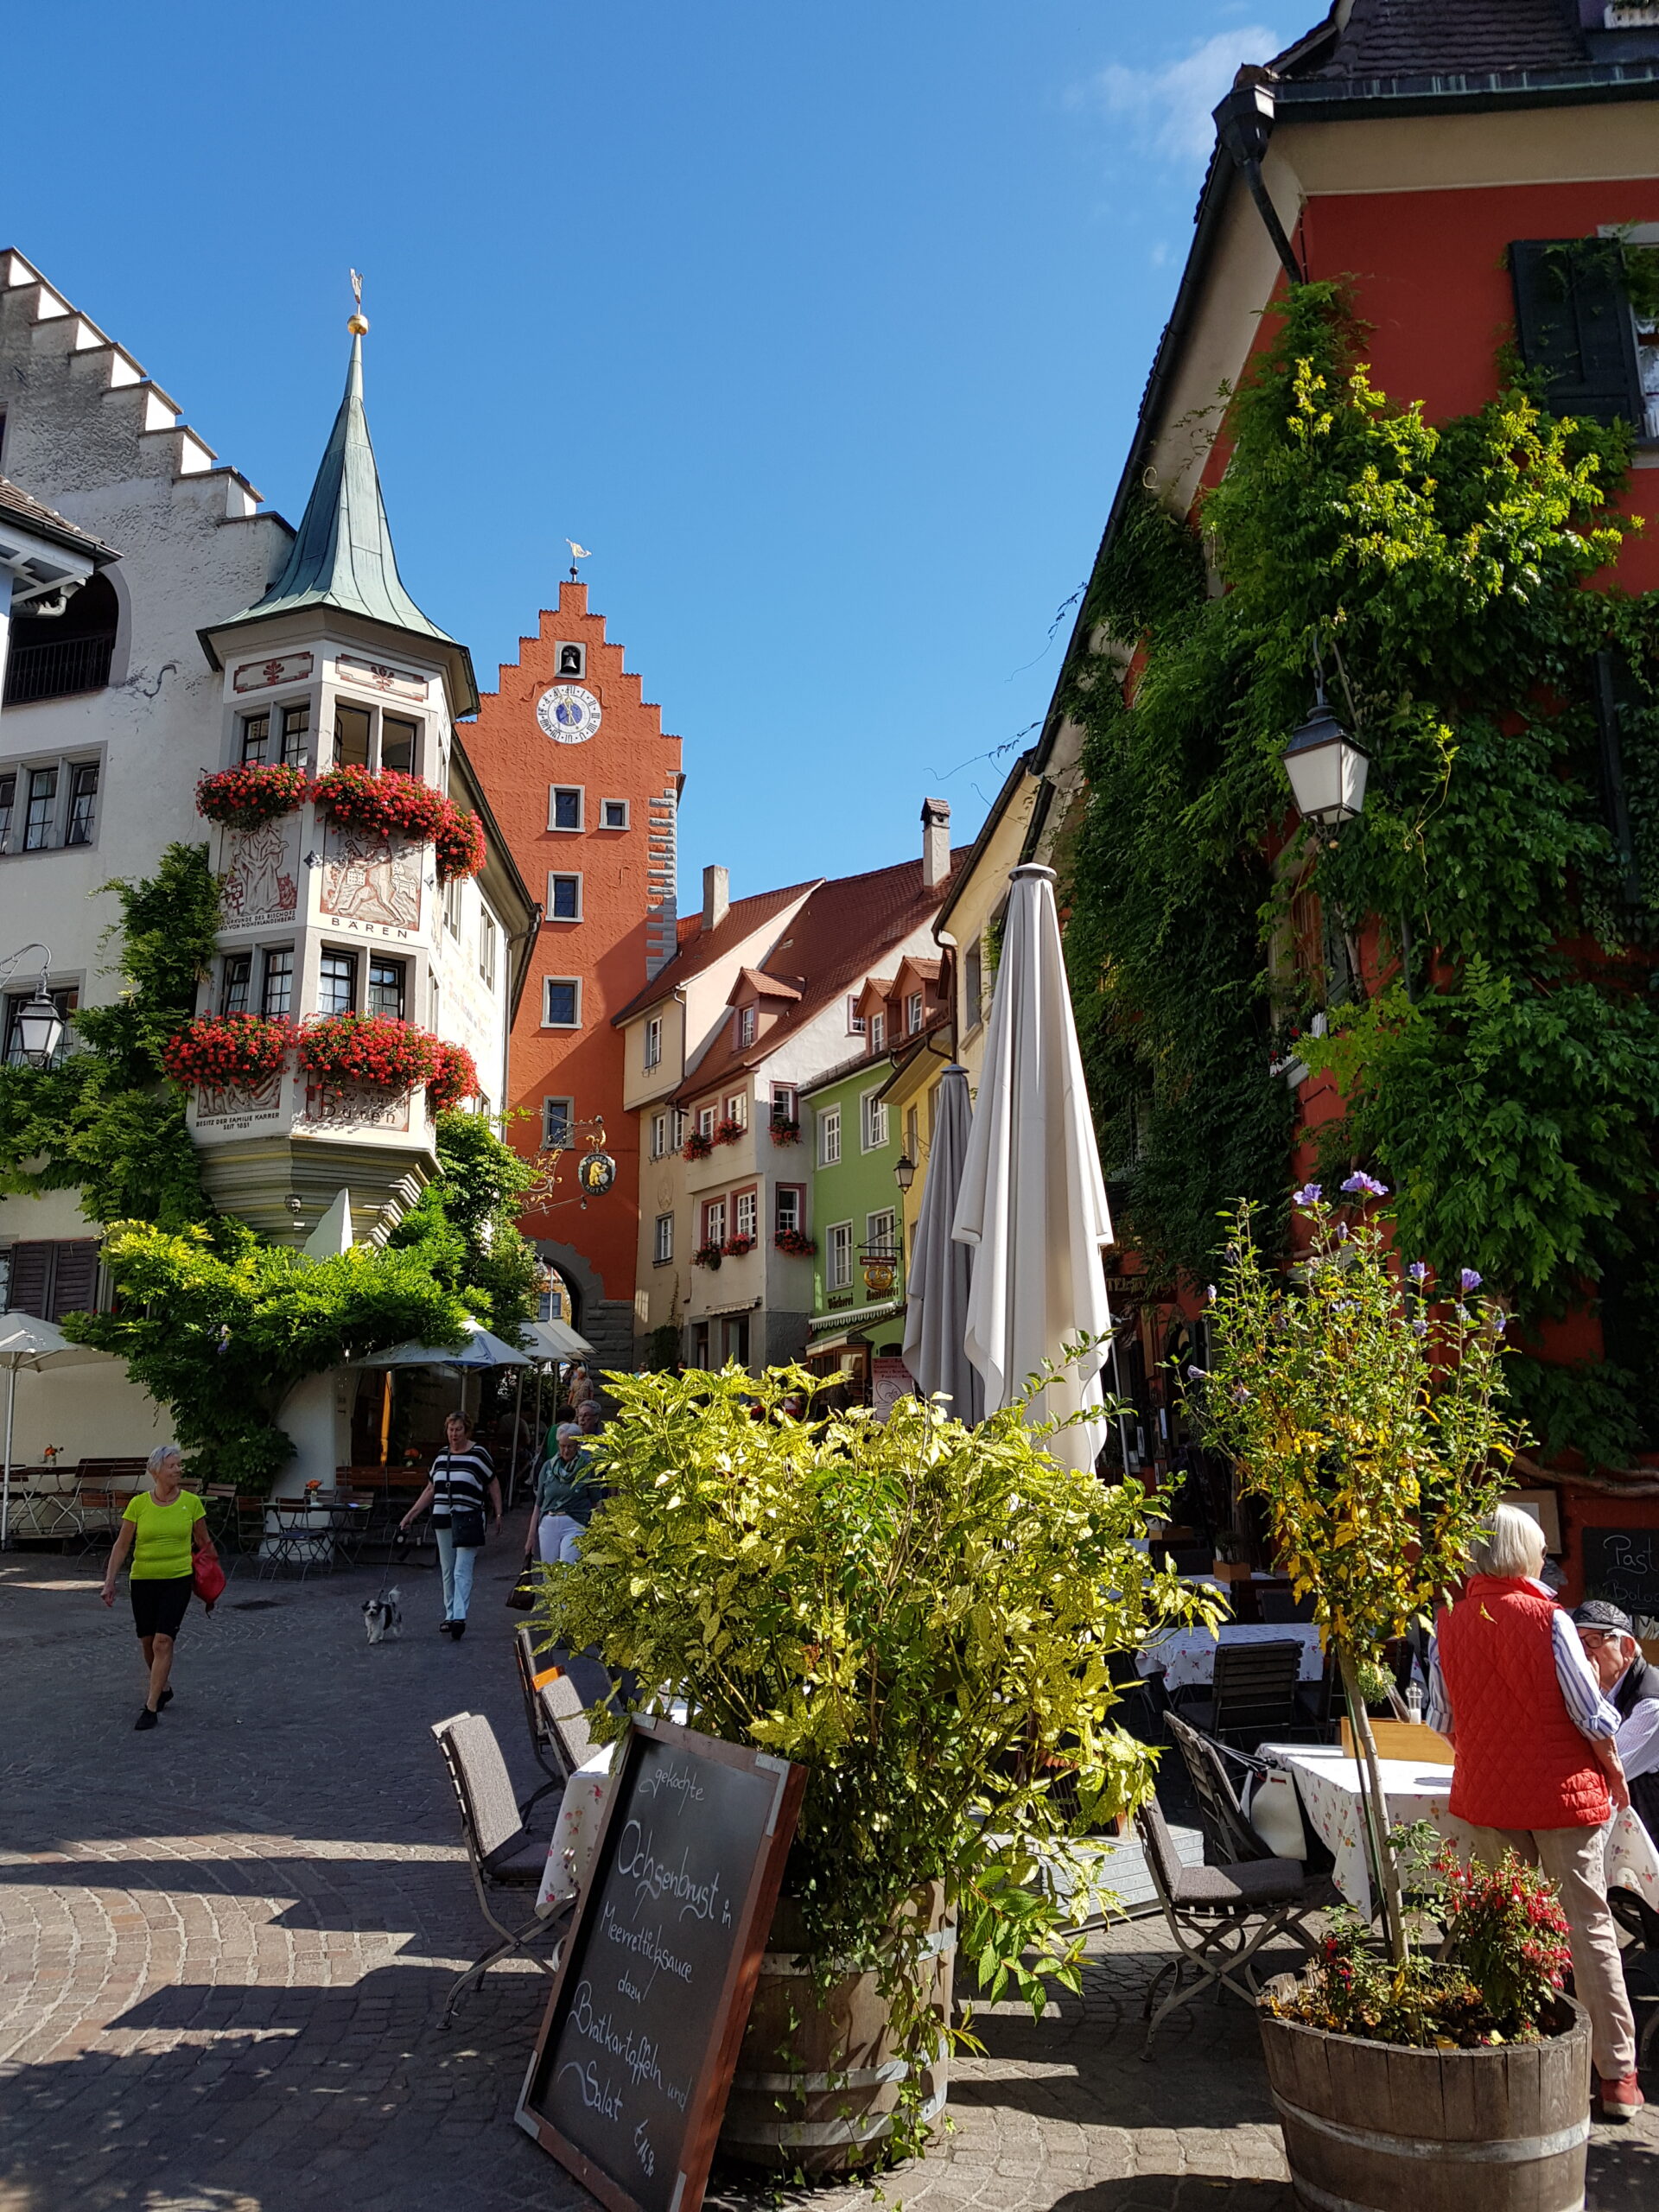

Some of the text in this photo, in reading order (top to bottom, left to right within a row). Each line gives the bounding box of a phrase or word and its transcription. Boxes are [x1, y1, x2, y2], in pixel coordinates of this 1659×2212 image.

[267, 910, 296, 919] BISCHOFS
[331, 917, 408, 939] BÄREN
[195, 1119, 215, 1128] BESITZ
[229, 1115, 253, 1124] FAMILIE
[254, 1112, 280, 1121] KARRER
[585, 1184, 609, 1193] HOTEL
[638, 1762, 705, 1816] gekochte
[617, 1819, 731, 1929] Ochsenbrust in
[600, 1900, 693, 2001] Meerrettichsauce
[617, 1969, 641, 2005] dazu
[566, 1980, 693, 2113] Bratkartoffeln und
[556, 2060, 624, 2123] Salat
